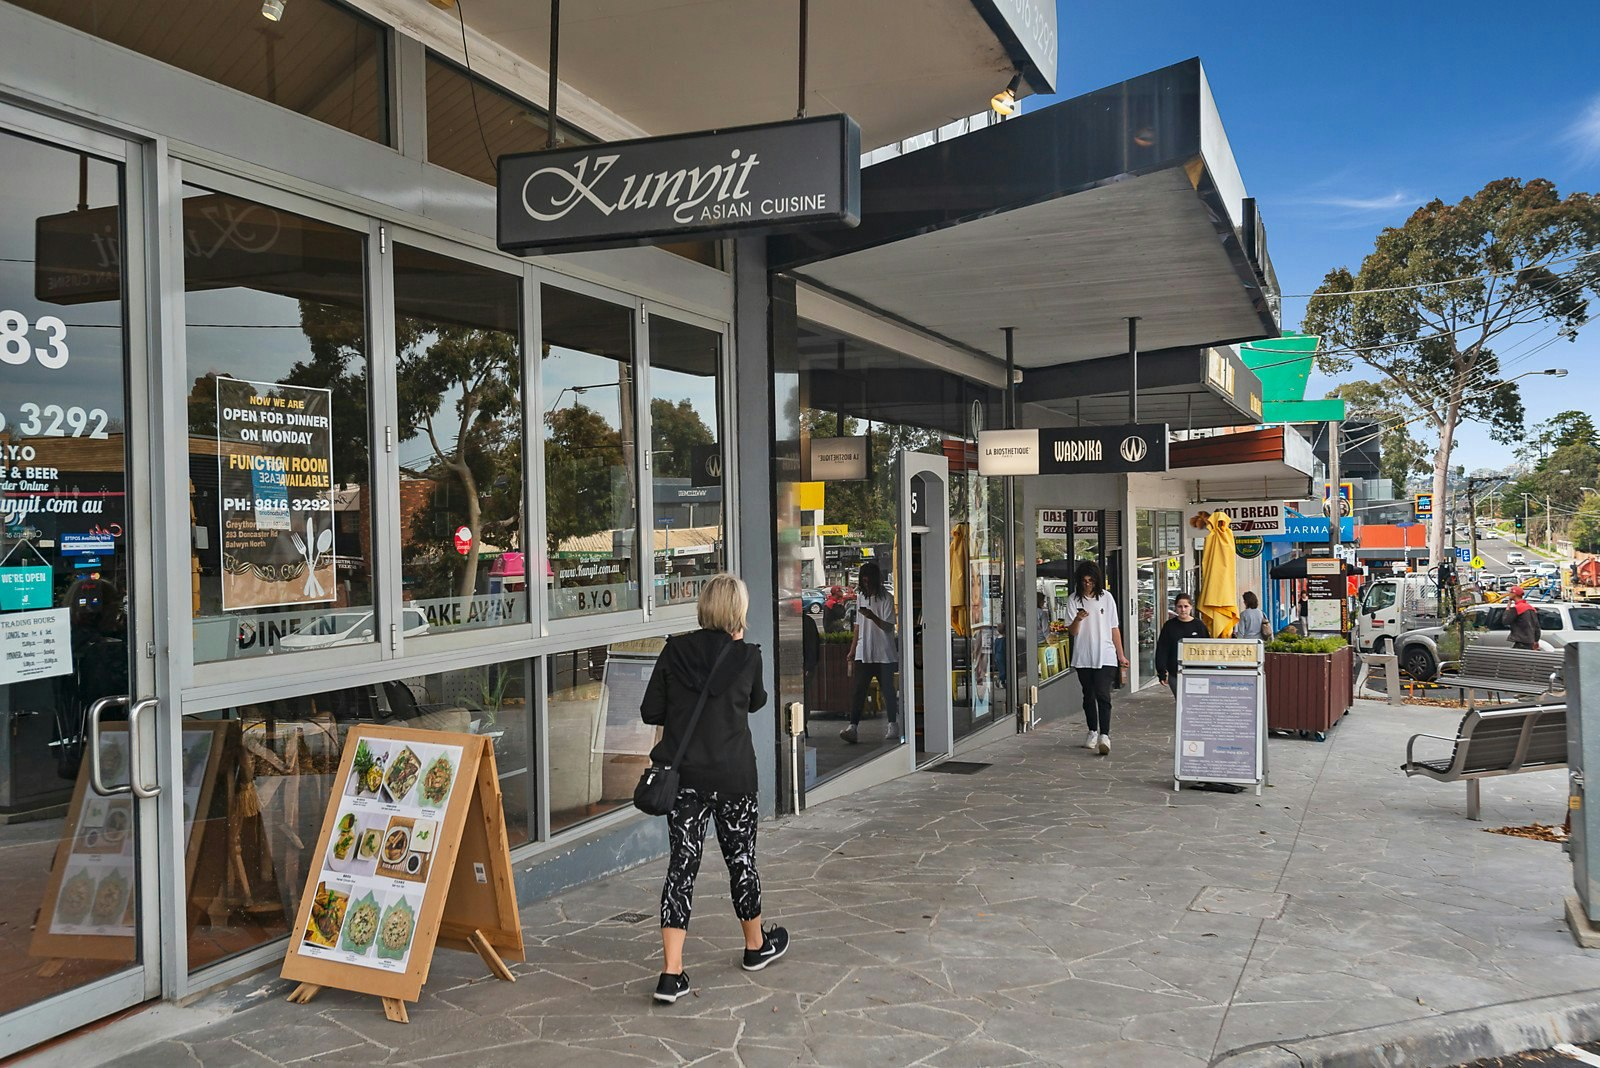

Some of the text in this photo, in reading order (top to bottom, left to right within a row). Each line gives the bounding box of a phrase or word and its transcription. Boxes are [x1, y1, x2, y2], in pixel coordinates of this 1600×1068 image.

[522, 149, 759, 224] Kunyit
[700, 193, 826, 221] ASIAN CUISINE
[250, 396, 305, 410] NOW WE ARE
[20, 402, 109, 440] 3292
[223, 407, 329, 428] OPEN FOR DINNER
[241, 428, 313, 445] ON MONDAY
[985, 448, 992, 456] LA
[1054, 439, 1103, 462] WARDIKA
[229, 454, 328, 473] FUNCTION ROOM
[11, 466, 22, 479] &
[26, 466, 59, 480] BEER
[19, 480, 49, 492] Online
[280, 474, 330, 488] AVAILABLE
[82, 500, 103, 514] au
[223, 498, 251, 511] PH:
[255, 498, 289, 511] 9816
[292, 499, 330, 511] 3292
[911, 492, 918, 514] 5
[1241, 505, 1279, 518] BREAD
[225, 520, 262, 530] Greythor
[1254, 522, 1278, 530] DAYS
[1285, 525, 1346, 534] HARMAY
[238, 530, 270, 538] Doncaster
[225, 540, 267, 549] Balwyn North
[1, 572, 46, 584] WE'RE OPEN
[559, 564, 620, 579] www.Kunyit.com.au
[578, 589, 612, 611] B.Y.O
[467, 597, 516, 624] AWAY
[1, 616, 56, 629] TRADING HOURS
